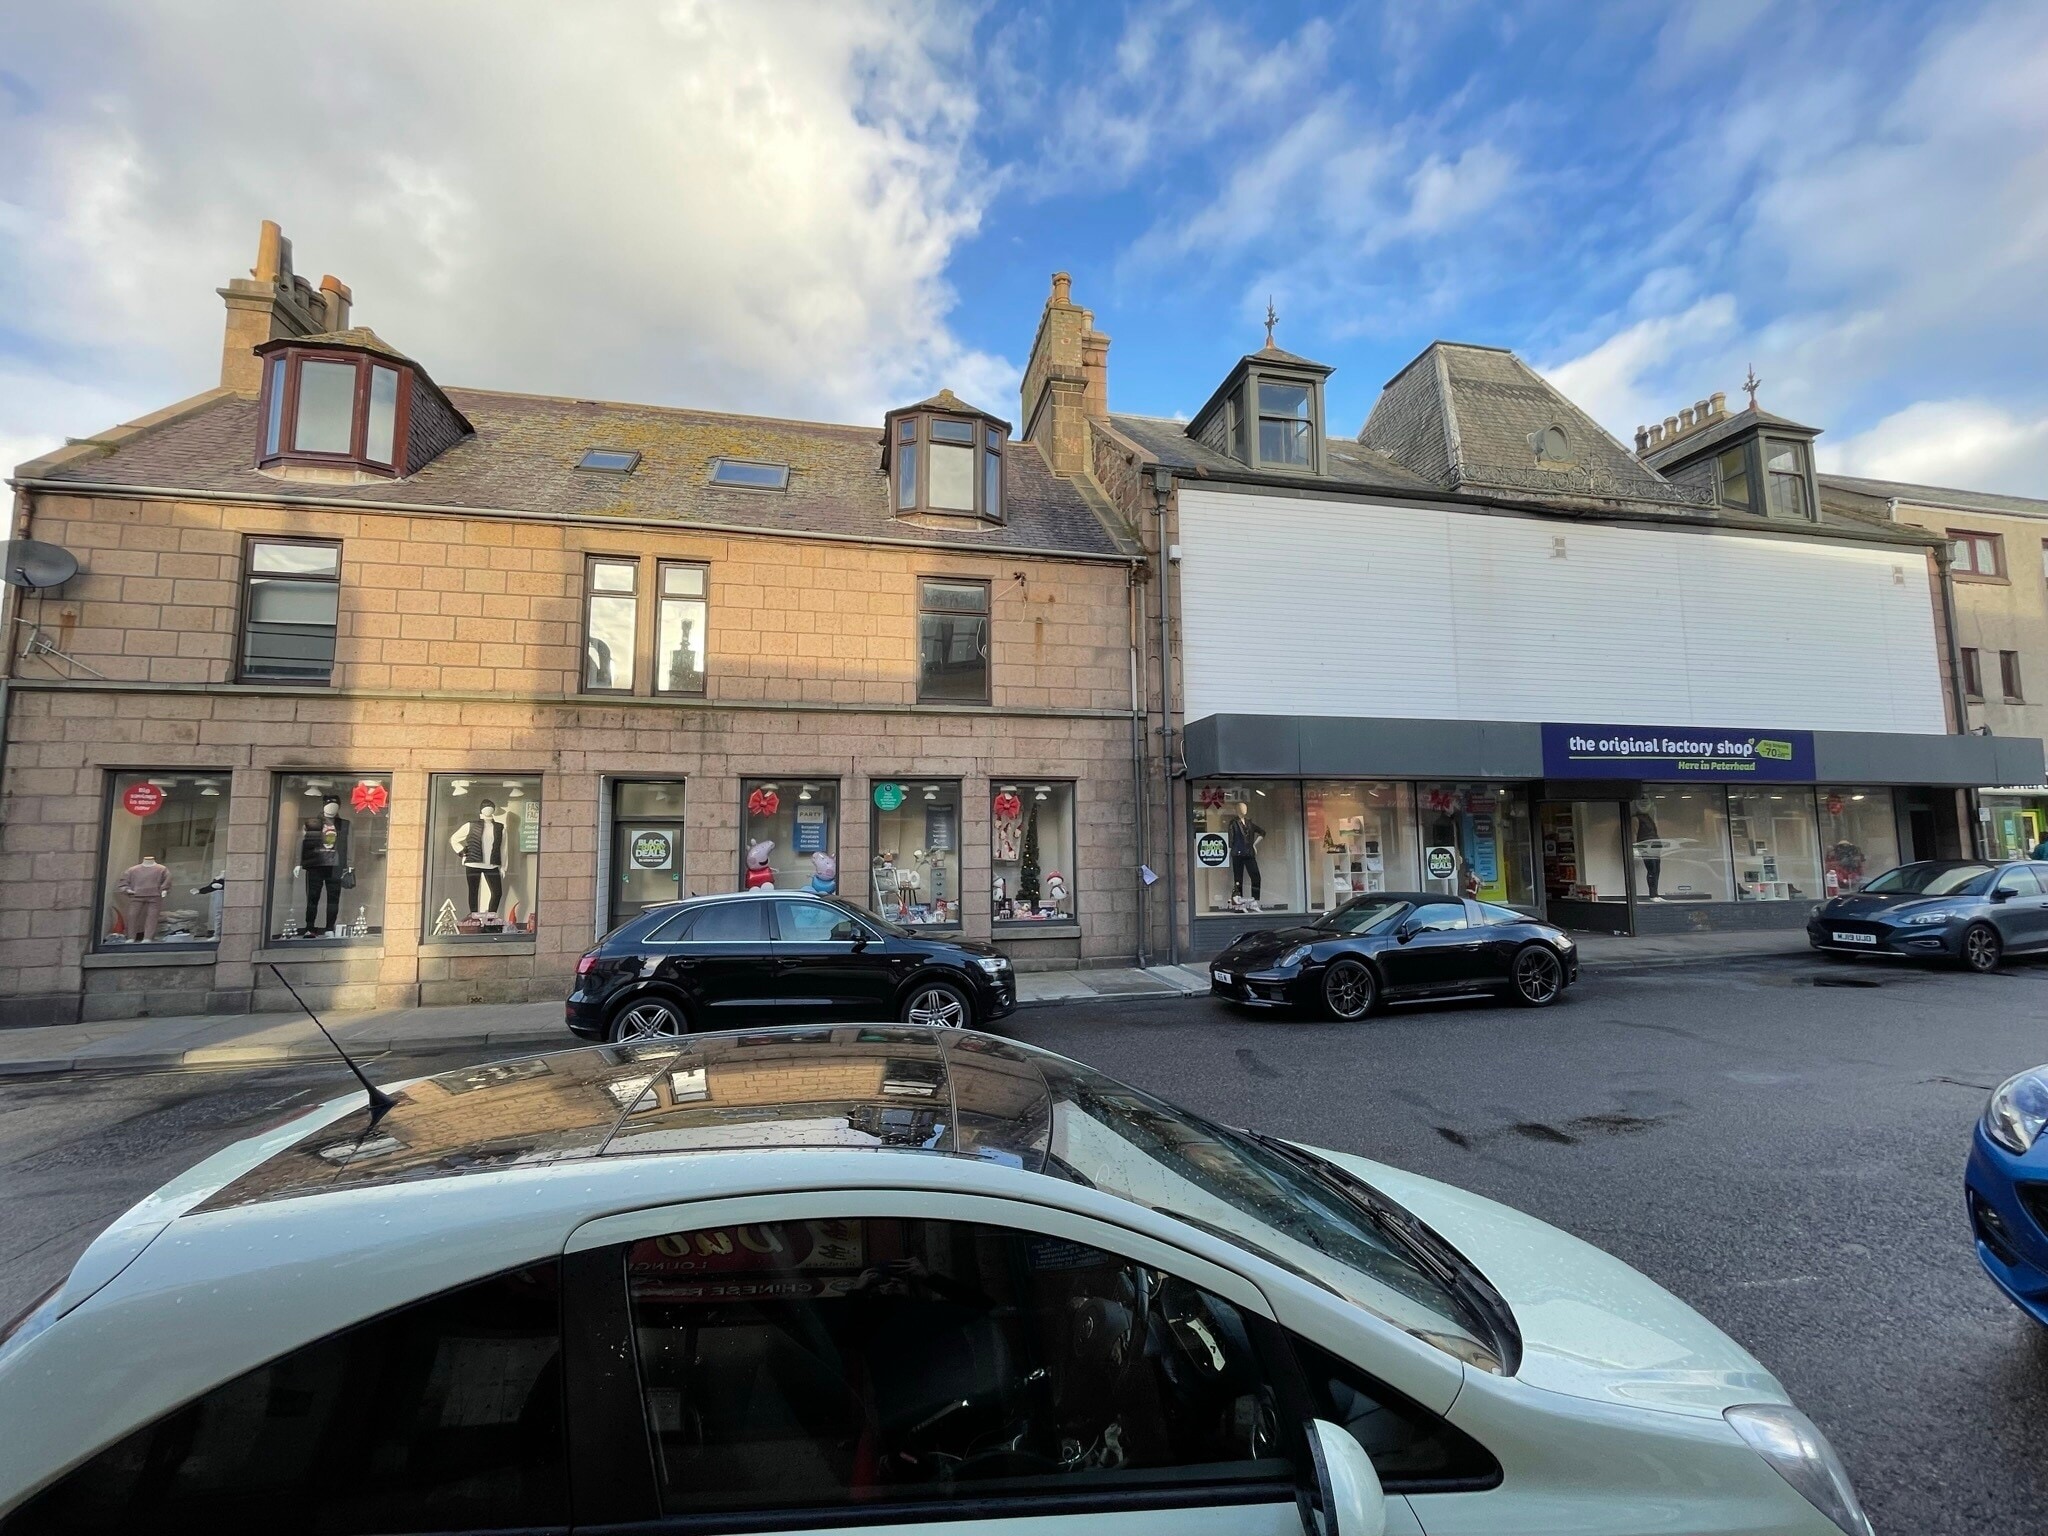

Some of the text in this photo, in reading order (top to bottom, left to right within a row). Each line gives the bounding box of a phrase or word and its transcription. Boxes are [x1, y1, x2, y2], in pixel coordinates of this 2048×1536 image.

[1569, 736, 1754, 757] the original factory shop
[1678, 760, 1756, 771] Here in Peterhead
